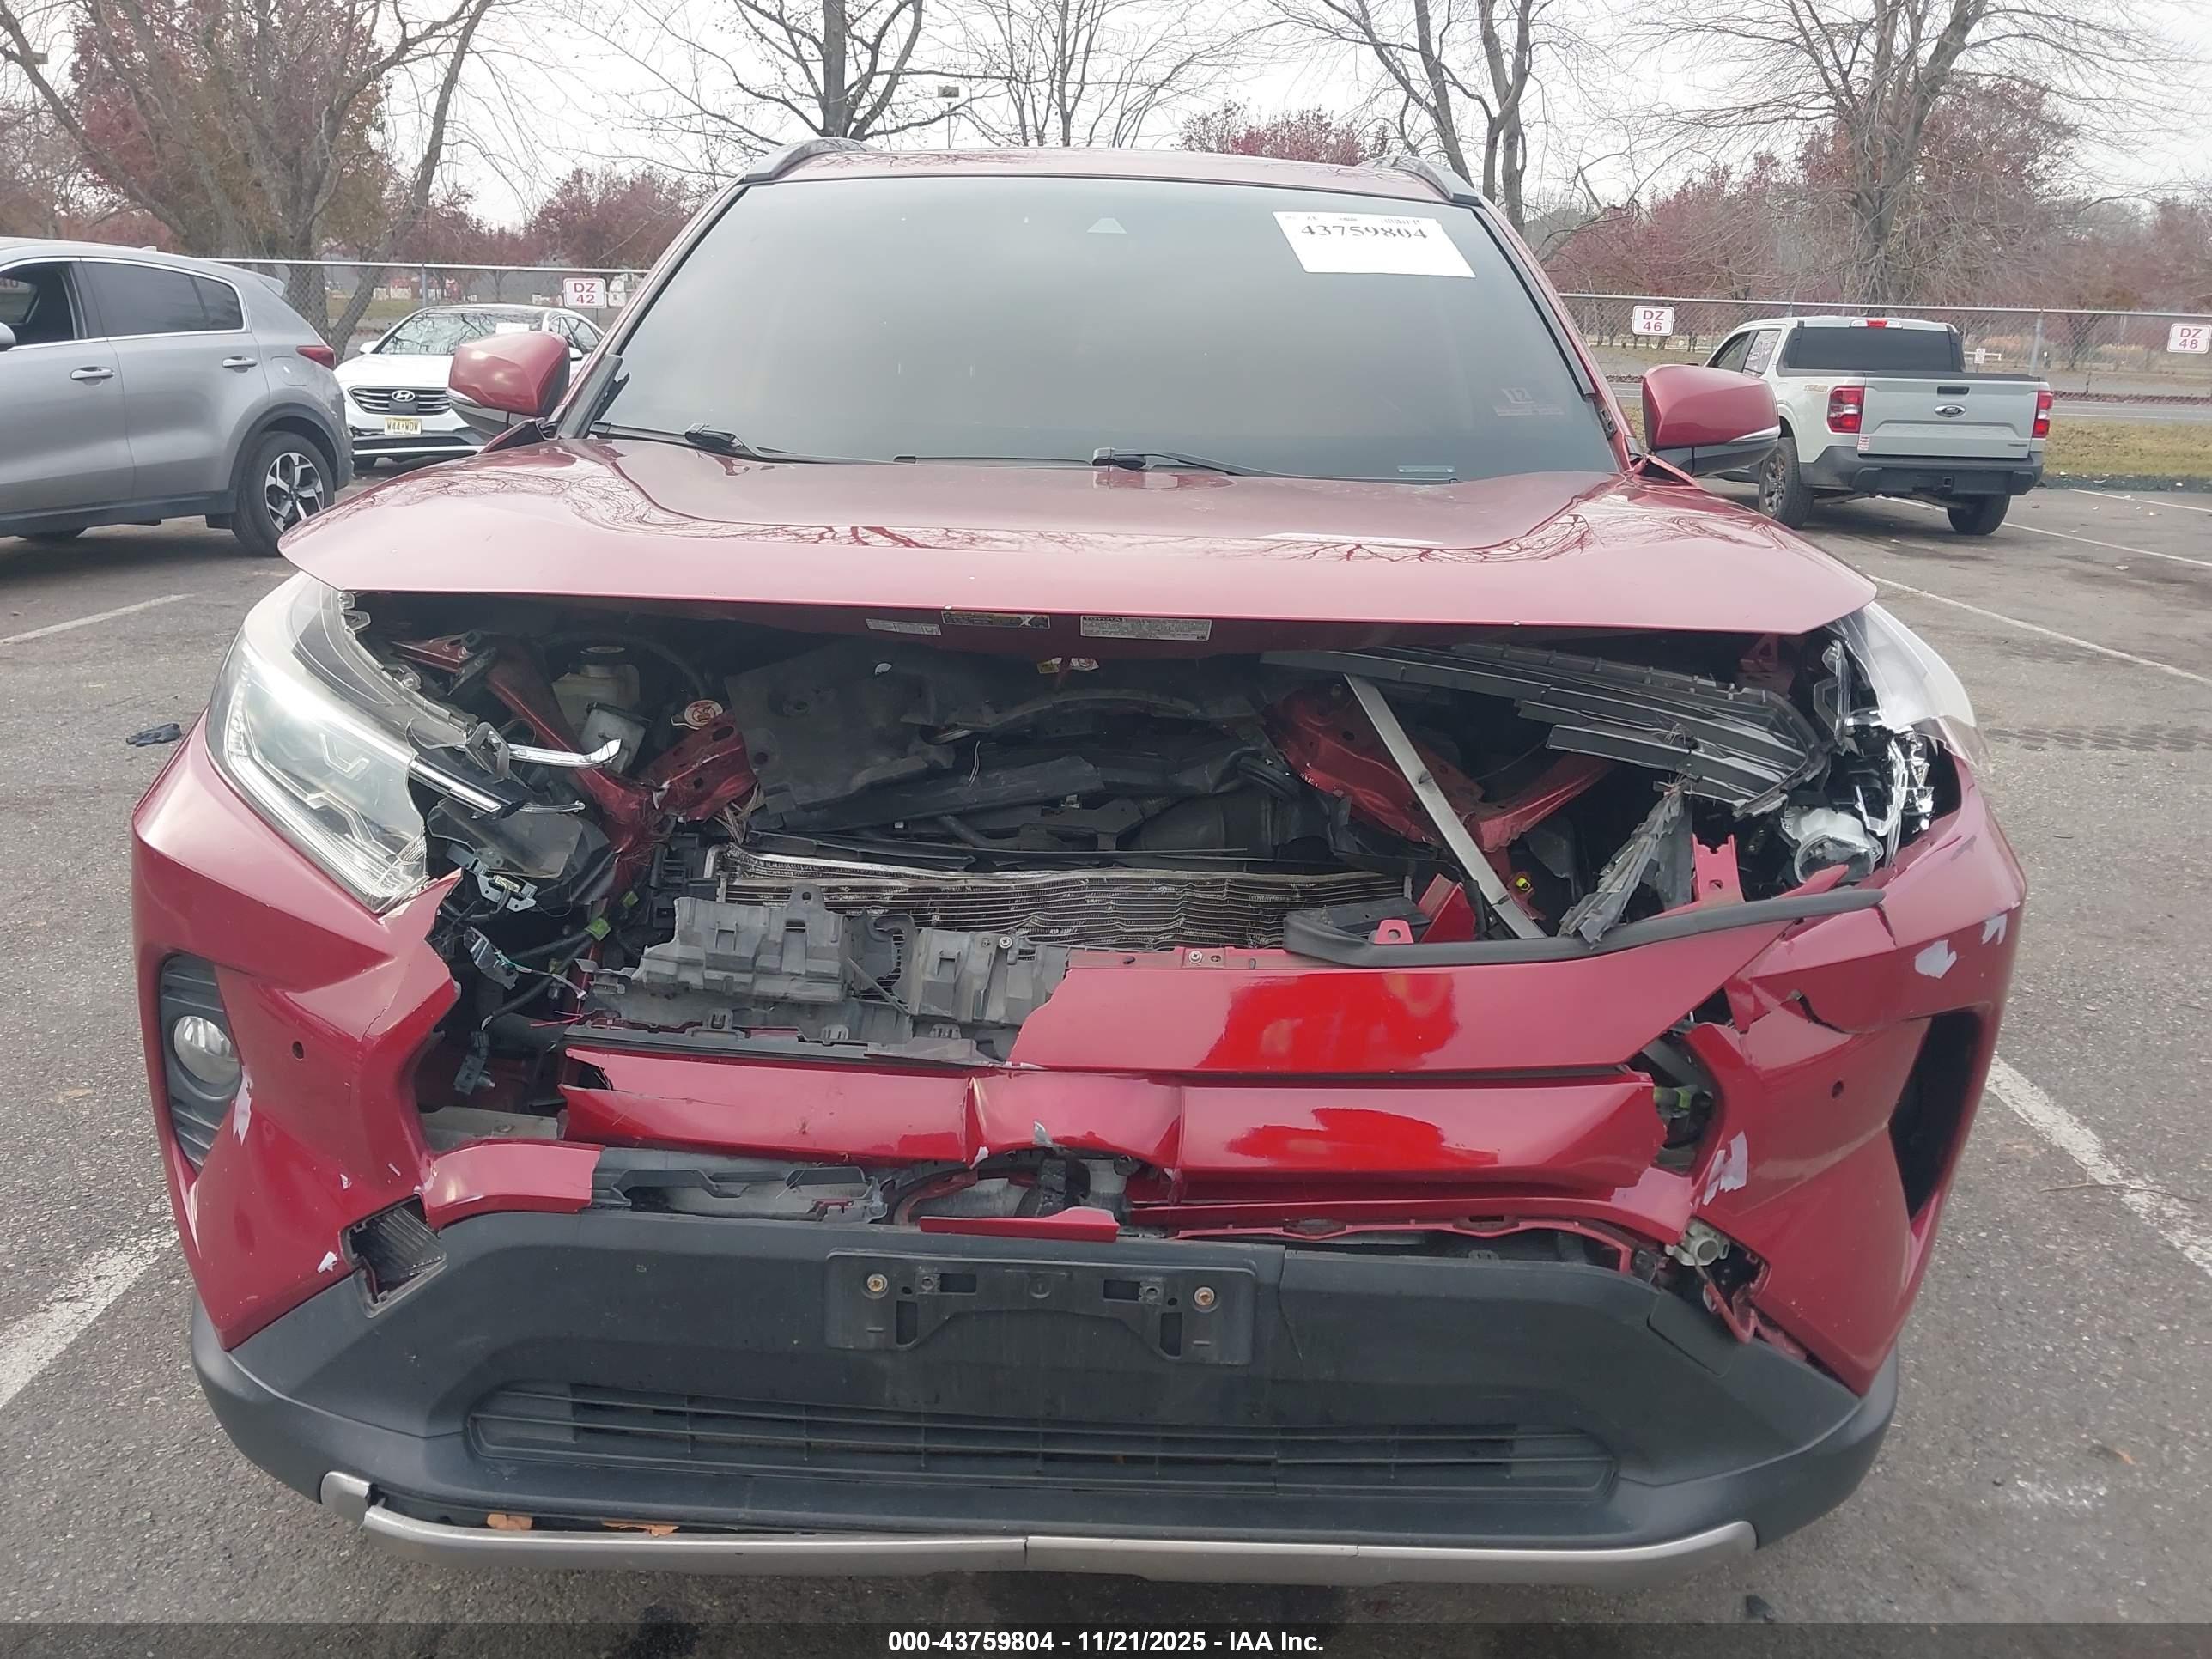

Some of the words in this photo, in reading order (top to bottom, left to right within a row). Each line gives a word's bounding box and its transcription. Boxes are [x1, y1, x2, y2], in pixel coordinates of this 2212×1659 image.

[1300, 224, 1428, 240] 43759804
[574, 283, 596, 293] DZ
[576, 294, 596, 304] 42
[1643, 310, 1665, 320] DZ
[1643, 322, 1662, 331] 46
[2179, 328, 2203, 338] DZ
[2179, 338, 2199, 349] 48
